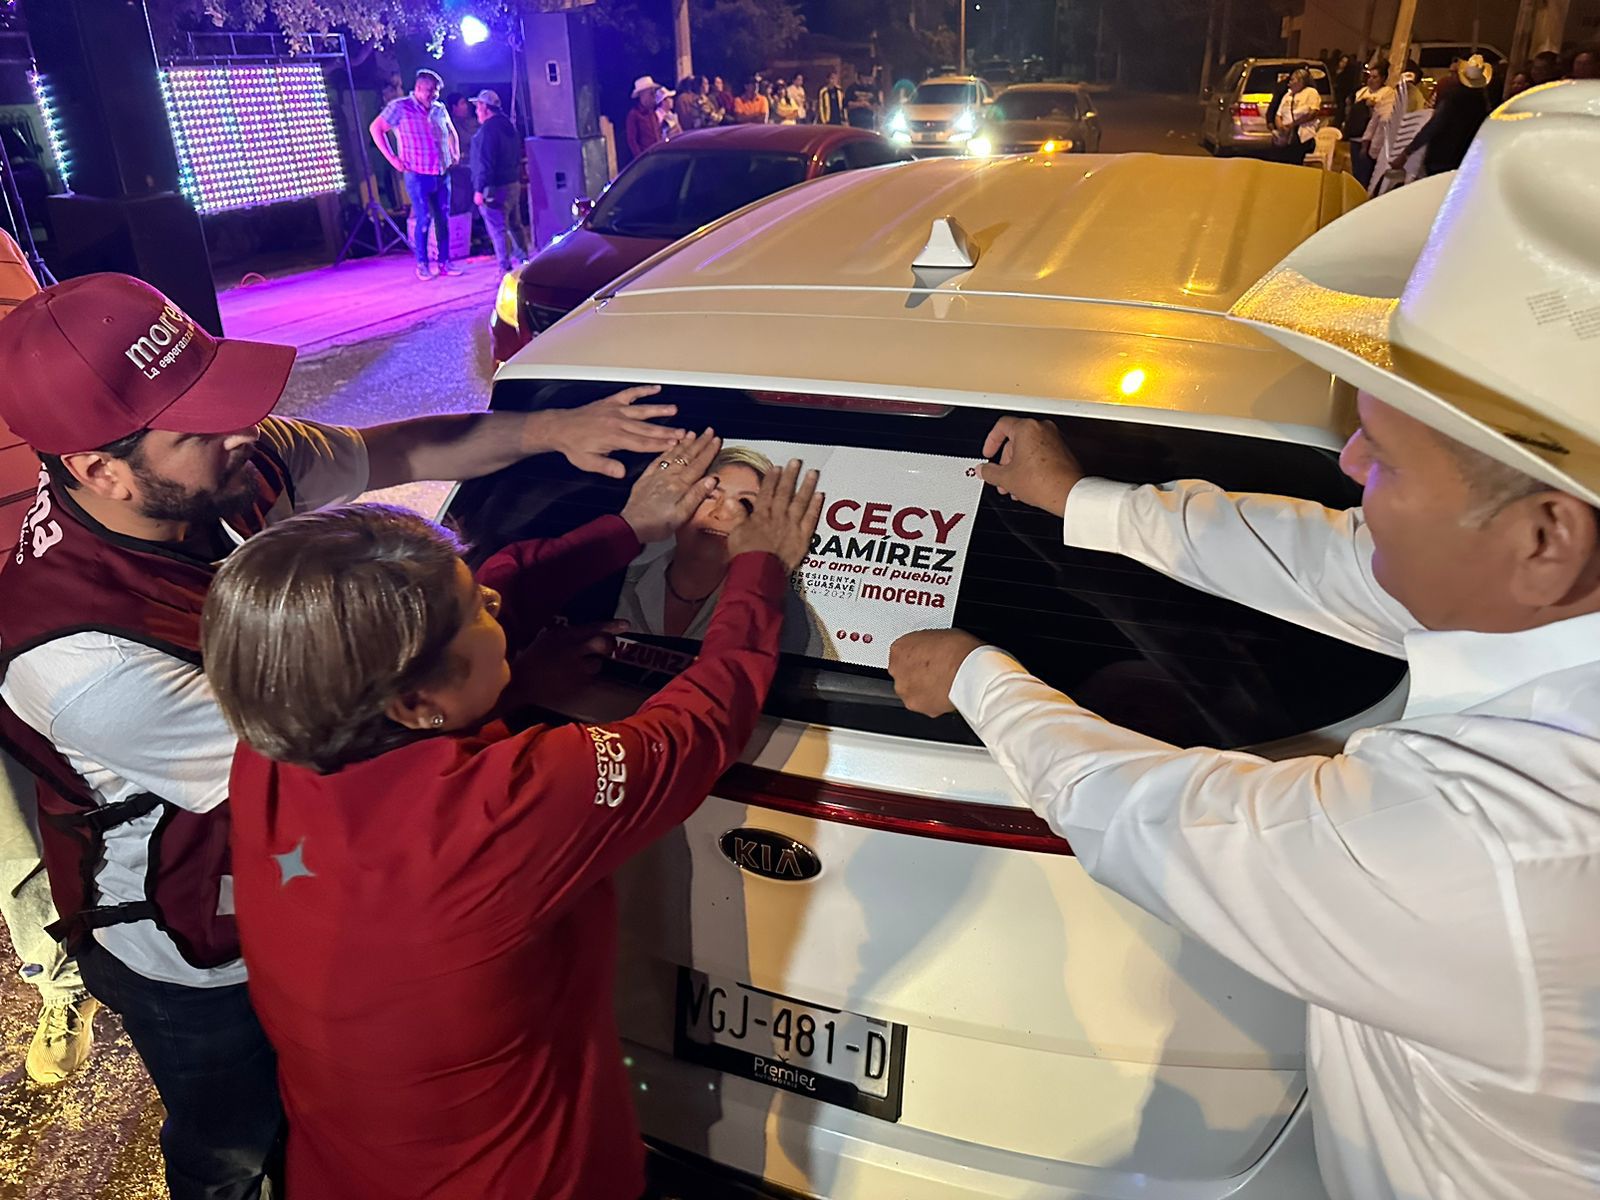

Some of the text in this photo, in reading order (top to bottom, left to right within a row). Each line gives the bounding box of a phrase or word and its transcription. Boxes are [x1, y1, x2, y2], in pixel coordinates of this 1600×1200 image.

[124, 305, 184, 370] more
[143, 366, 161, 380] La
[825, 499, 966, 544] CECY
[809, 533, 957, 573] RAMÍREZ
[828, 560, 870, 575] amor
[872, 563, 888, 578] al
[890, 567, 952, 586] pueblo!
[807, 580, 856, 593] GUASAVE
[860, 582, 946, 609] morena
[597, 726, 627, 808] CECY
[734, 836, 803, 878] KIA
[688, 979, 887, 1081] VGJ-481-D
[753, 1056, 817, 1091] Premier
